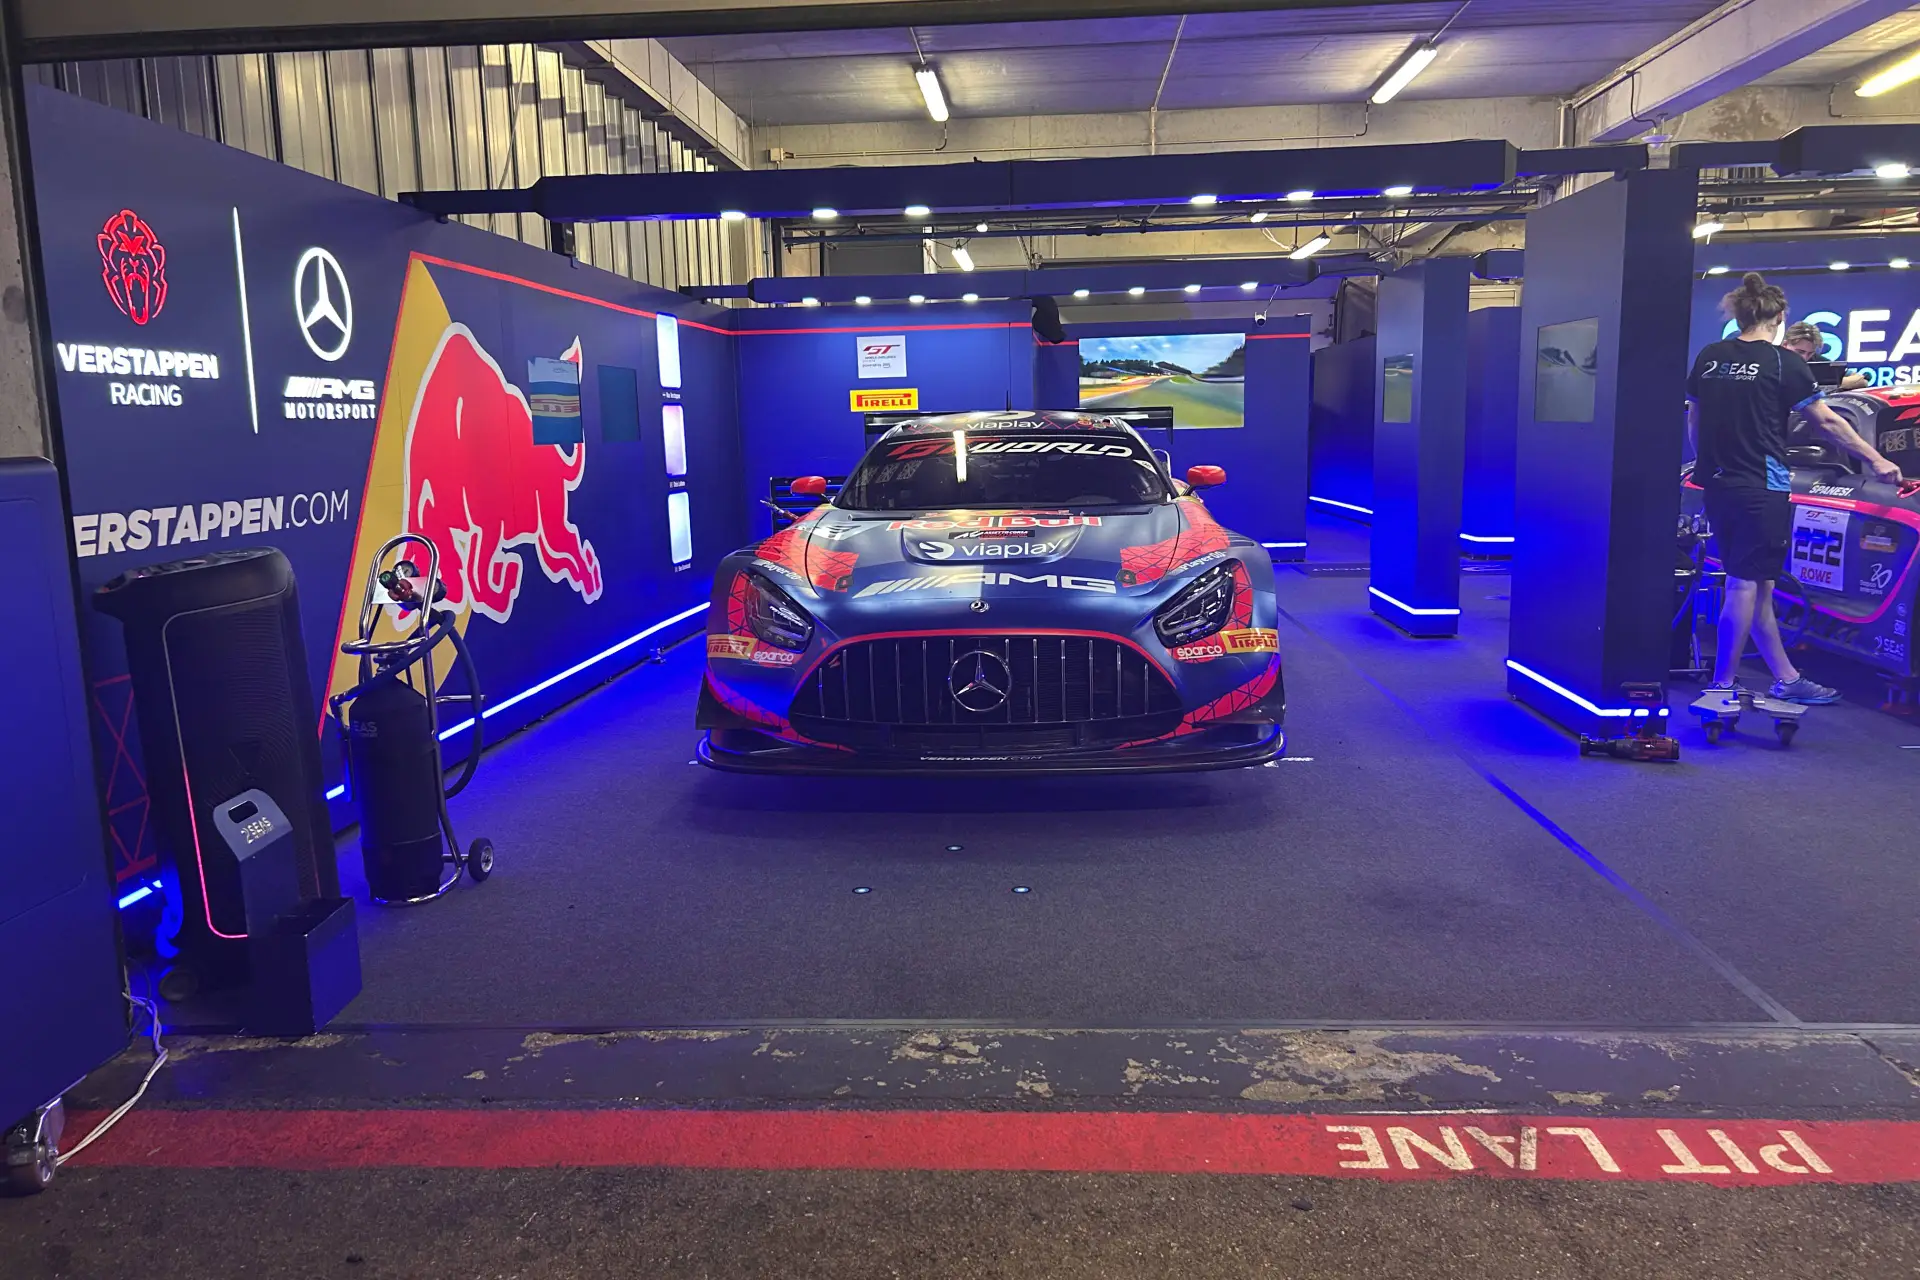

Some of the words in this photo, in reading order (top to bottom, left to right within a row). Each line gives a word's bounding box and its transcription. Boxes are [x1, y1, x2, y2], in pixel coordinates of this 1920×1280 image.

[57, 343, 219, 379] VERSTAPPEN
[1719, 363, 1760, 376] SEAS
[110, 382, 183, 407] RACING
[856, 394, 911, 408] PIRELLI
[284, 402, 376, 419] MOTORSPORT
[966, 419, 1046, 430] viaplay
[968, 442, 1133, 458] WORLD
[1809, 485, 1854, 496] SPANESI
[73, 489, 349, 558] ERSTAPPEN.COM
[886, 516, 991, 531] Red
[1000, 515, 1102, 528] Bull
[962, 538, 1064, 559] viaplay
[1794, 526, 1843, 567] 222
[1800, 566, 1832, 584] ROWE
[753, 651, 794, 662] sparco
[1176, 645, 1223, 659] sparco
[1325, 1125, 1622, 1172] LANE
[1656, 1128, 1834, 1175] PIT
